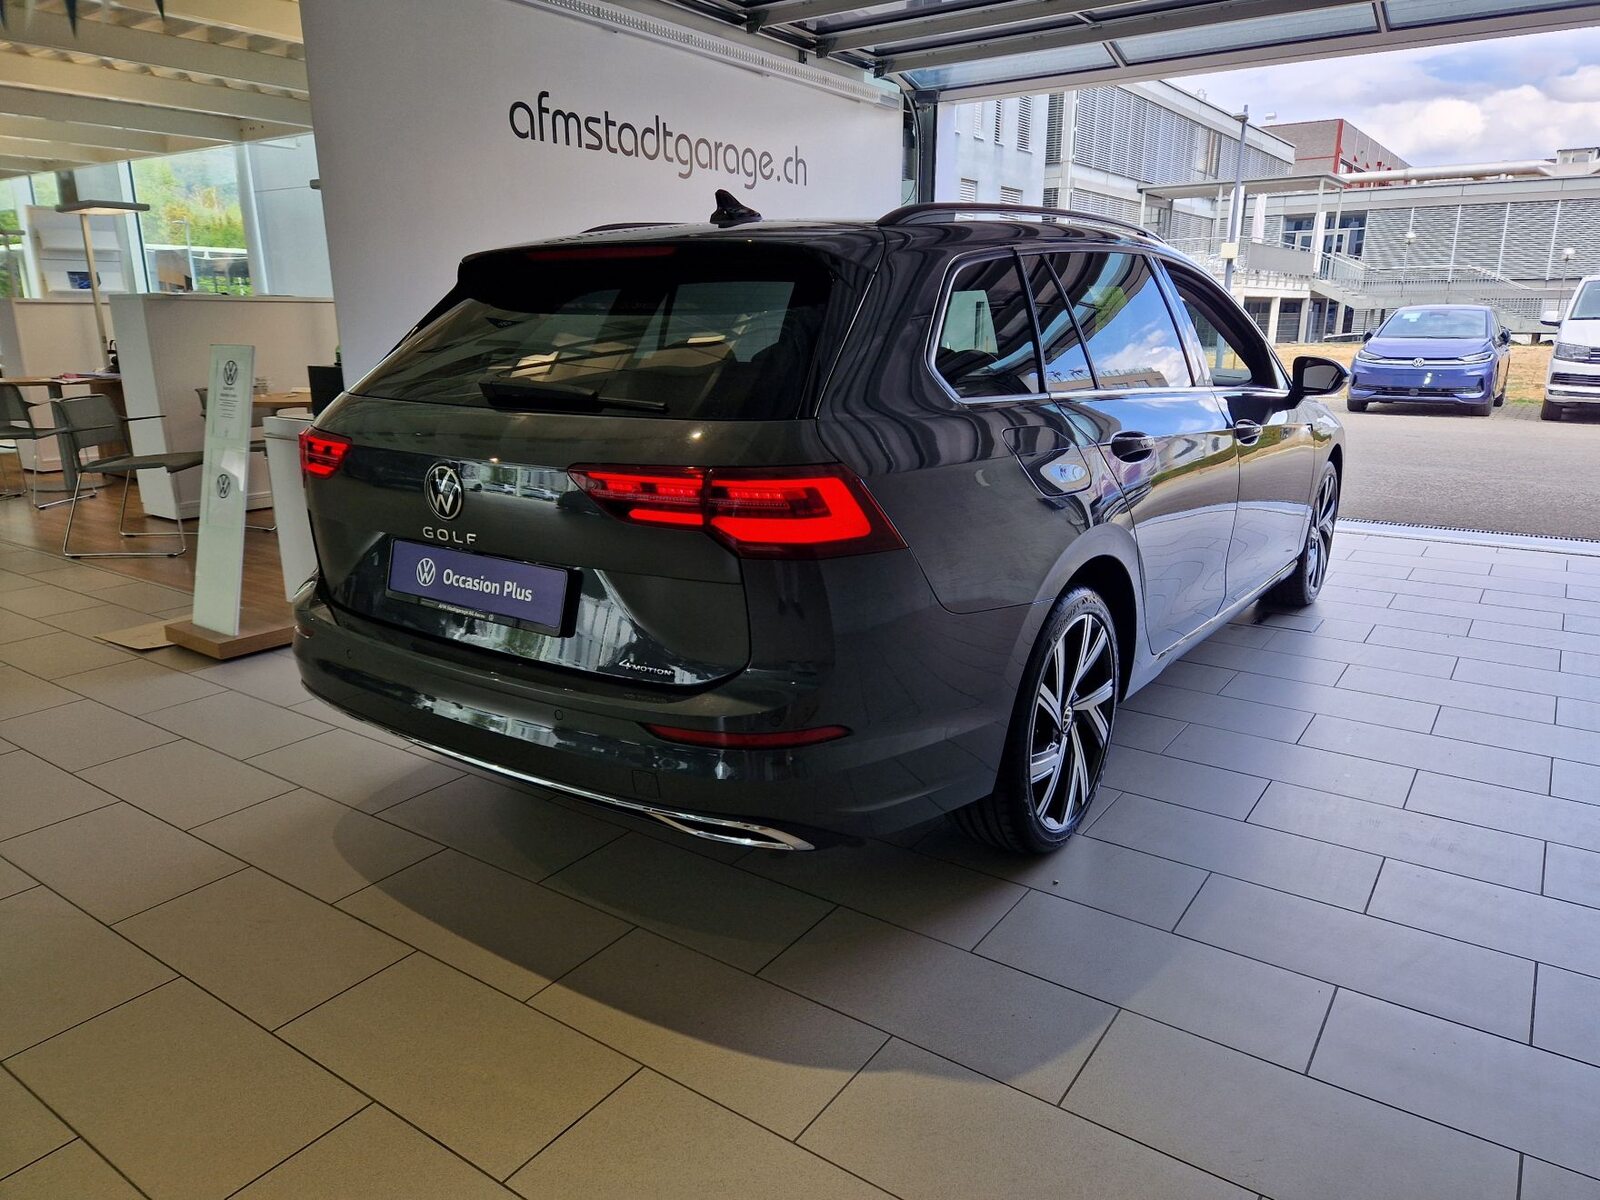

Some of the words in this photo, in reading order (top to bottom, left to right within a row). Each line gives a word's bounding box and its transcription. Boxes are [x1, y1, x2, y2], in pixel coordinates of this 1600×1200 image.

[508, 90, 808, 190] afmstadtgarage.ch
[422, 526, 477, 545] GOLF
[443, 568, 500, 595] Occasion
[503, 580, 533, 602] Plus
[618, 658, 673, 676] 4MOTION
